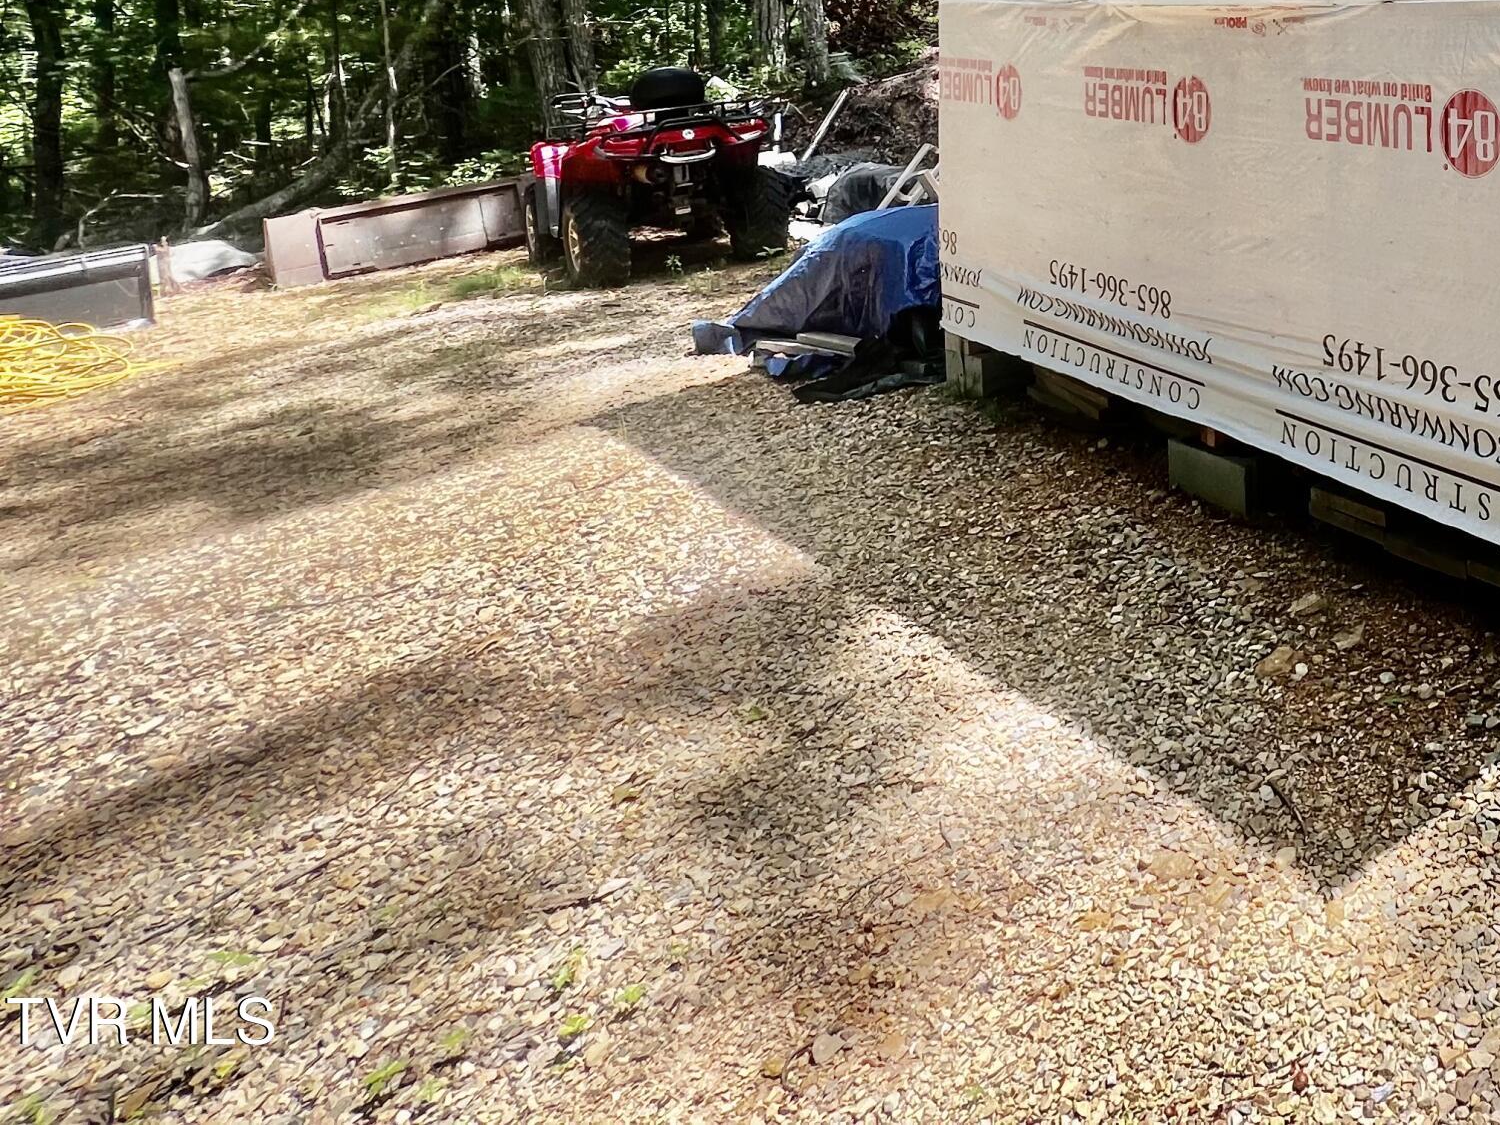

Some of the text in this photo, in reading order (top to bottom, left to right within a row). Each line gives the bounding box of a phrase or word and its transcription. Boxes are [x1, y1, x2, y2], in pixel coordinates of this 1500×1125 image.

[939, 71, 993, 106] LUMBE
[1334, 78, 1351, 93] we
[1352, 79, 1382, 99] what
[1382, 81, 1398, 97] on
[1400, 83, 1432, 103] Build
[1084, 82, 1167, 126] LUMBER
[1304, 97, 1496, 162] 84 LUMBER
[1049, 259, 1172, 319] 865-366-1495
[1023, 328, 1201, 410] CONSTRUCTION
